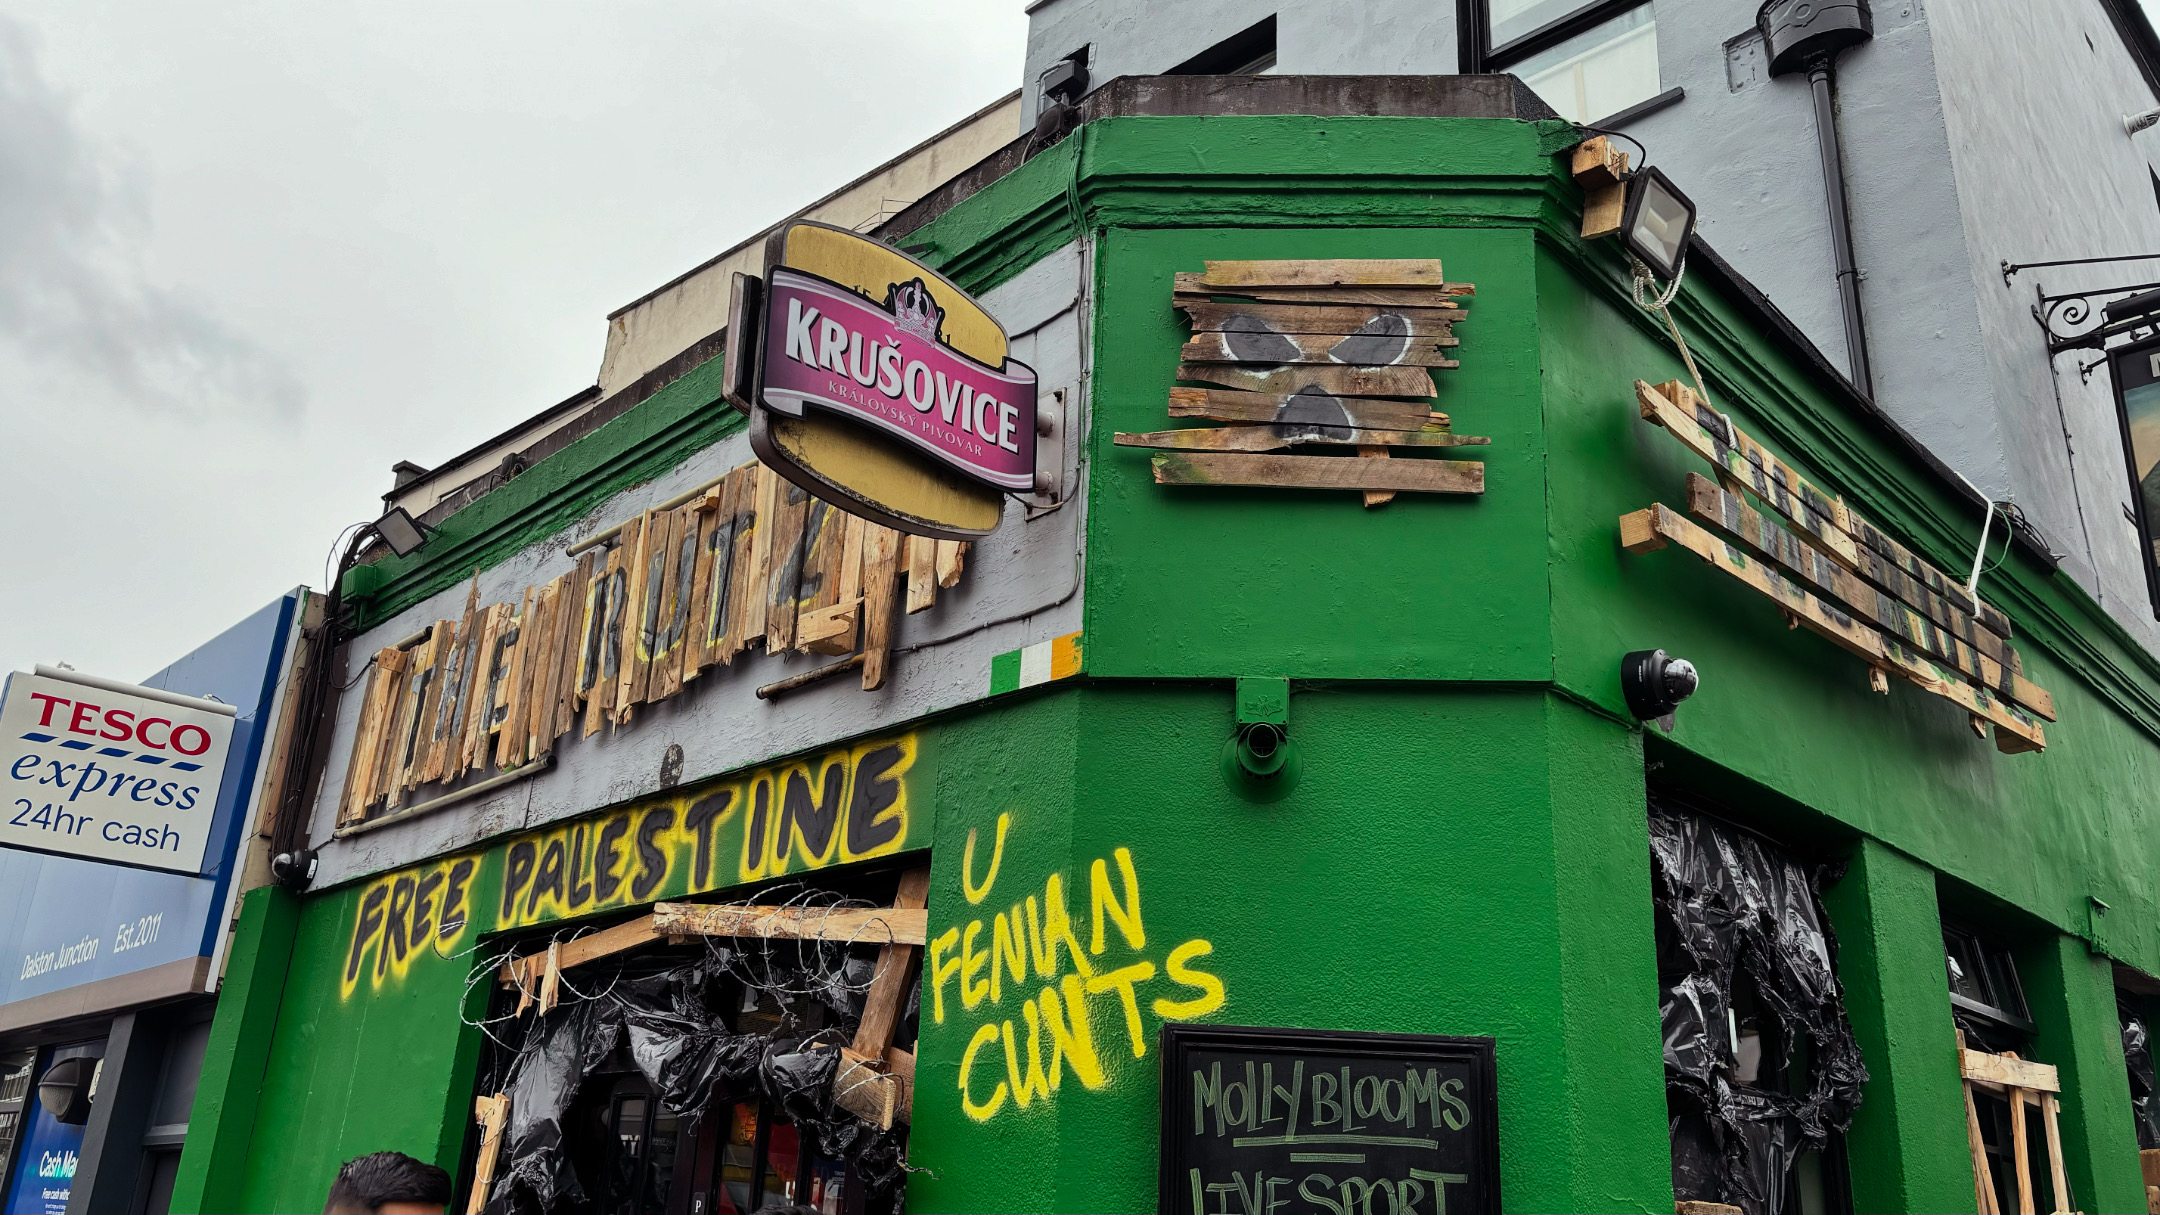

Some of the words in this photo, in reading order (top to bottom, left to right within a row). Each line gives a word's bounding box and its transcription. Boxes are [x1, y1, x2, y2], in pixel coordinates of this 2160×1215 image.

[784, 297, 1020, 455] KRUŠOVICE
[828, 380, 917, 427] KRÁLOVSKÝ
[921, 421, 983, 457] PIVOVAR
[30, 692, 212, 756] TESCO
[10, 753, 201, 811] express
[9, 798, 94, 836] 24hr
[102, 821, 181, 852] cash
[962, 811, 1009, 904] U
[342, 856, 480, 993] FREE
[500, 738, 911, 926] PALESTINE
[20, 951, 55, 981] Dalston
[53, 934, 100, 971] Junction
[929, 846, 1145, 1023] FENIAN
[958, 938, 1225, 1122] CUNTS
[1193, 1060, 1304, 1141] MOLLY
[1310, 1066, 1471, 1133] BLOOMS
[39, 1150, 62, 1178] Cash
[1297, 1167, 1468, 1215] SPORT
